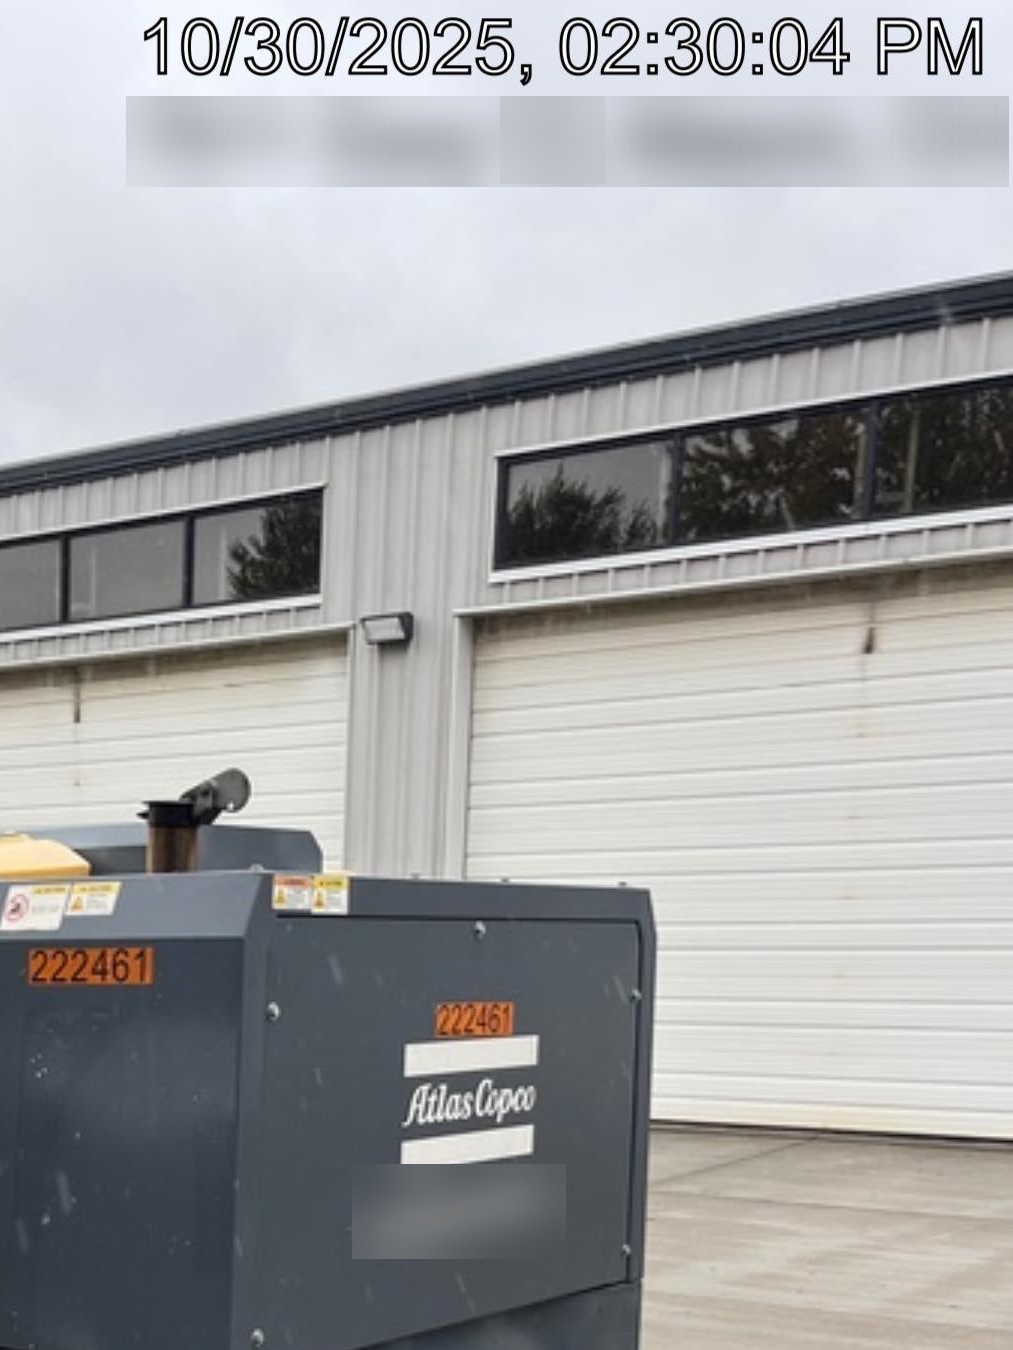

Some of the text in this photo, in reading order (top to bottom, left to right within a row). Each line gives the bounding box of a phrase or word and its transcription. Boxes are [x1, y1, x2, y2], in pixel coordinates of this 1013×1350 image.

[30, 948, 149, 985] 222461
[438, 1003, 511, 1036] 222461
[402, 1077, 537, 1127] Atlas Copco
